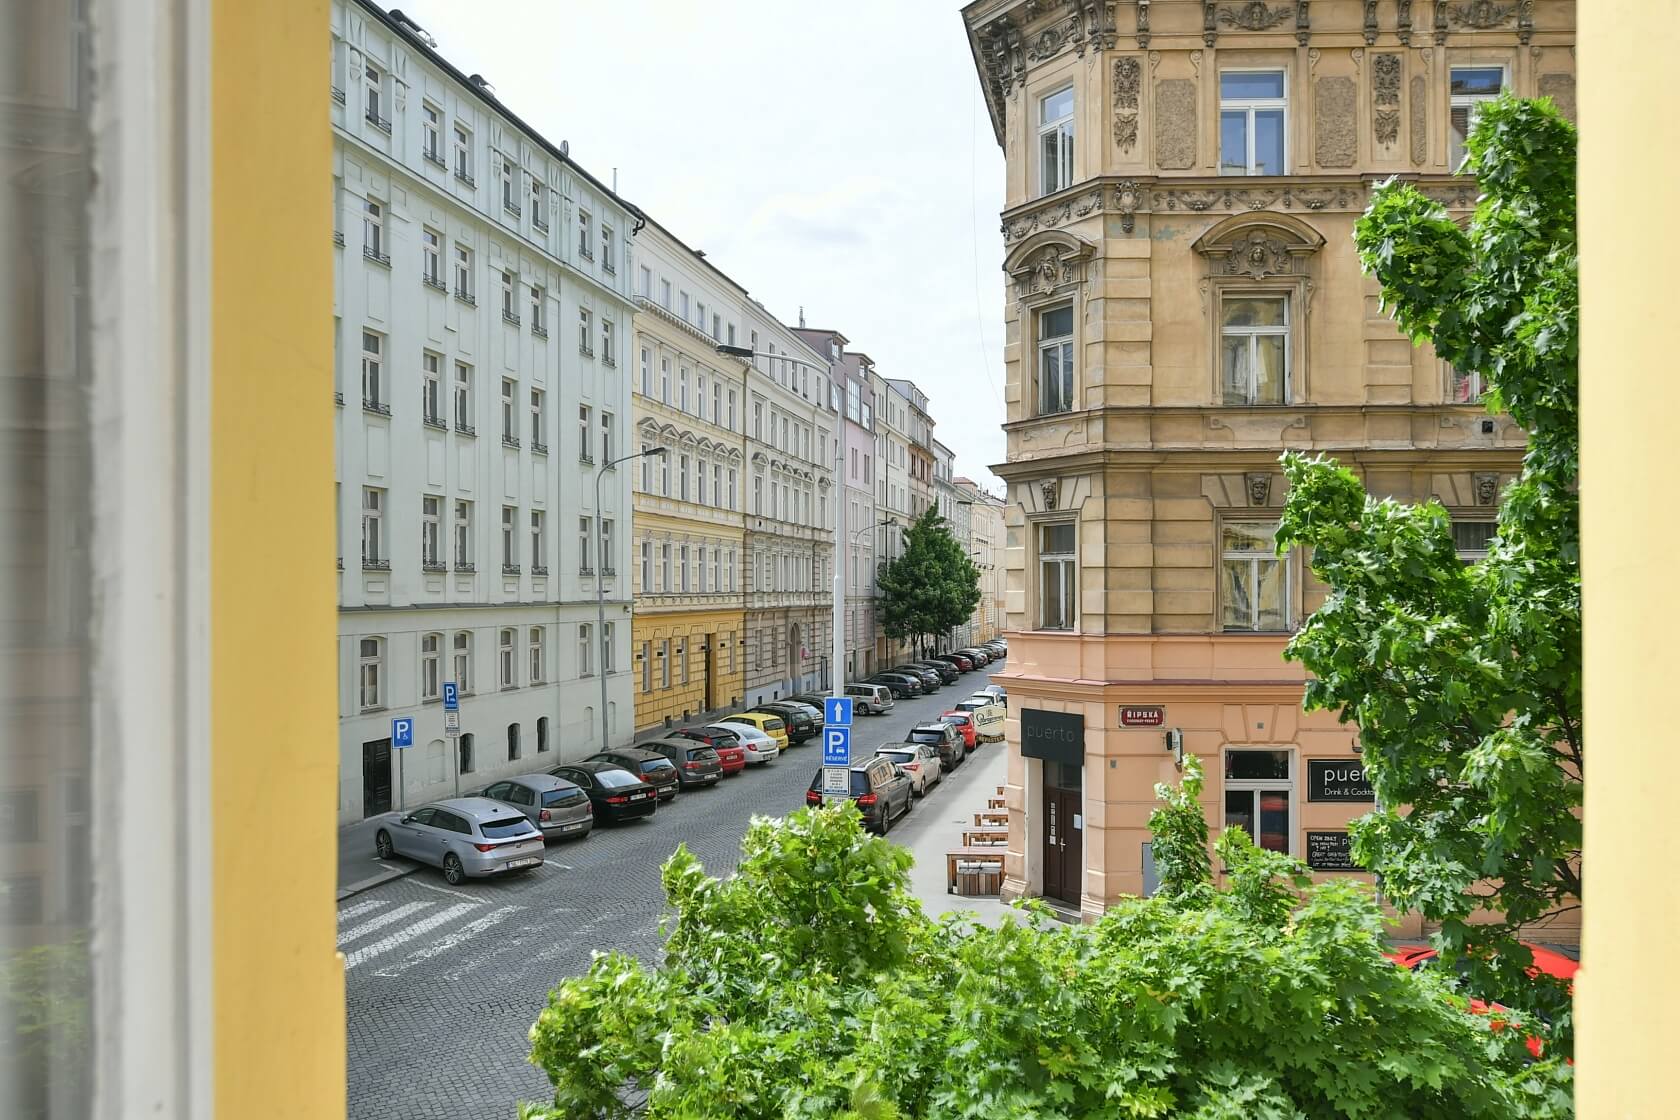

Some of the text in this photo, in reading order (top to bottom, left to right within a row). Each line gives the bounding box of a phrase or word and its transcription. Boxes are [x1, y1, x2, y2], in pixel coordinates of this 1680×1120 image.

[446, 686, 454, 702] P
[397, 721, 409, 740] P
[1027, 726, 1074, 742] puerto
[828, 731, 844, 753] P
[1324, 769, 1369, 786] puer
[1324, 788, 1376, 796] Drink & Cockta
